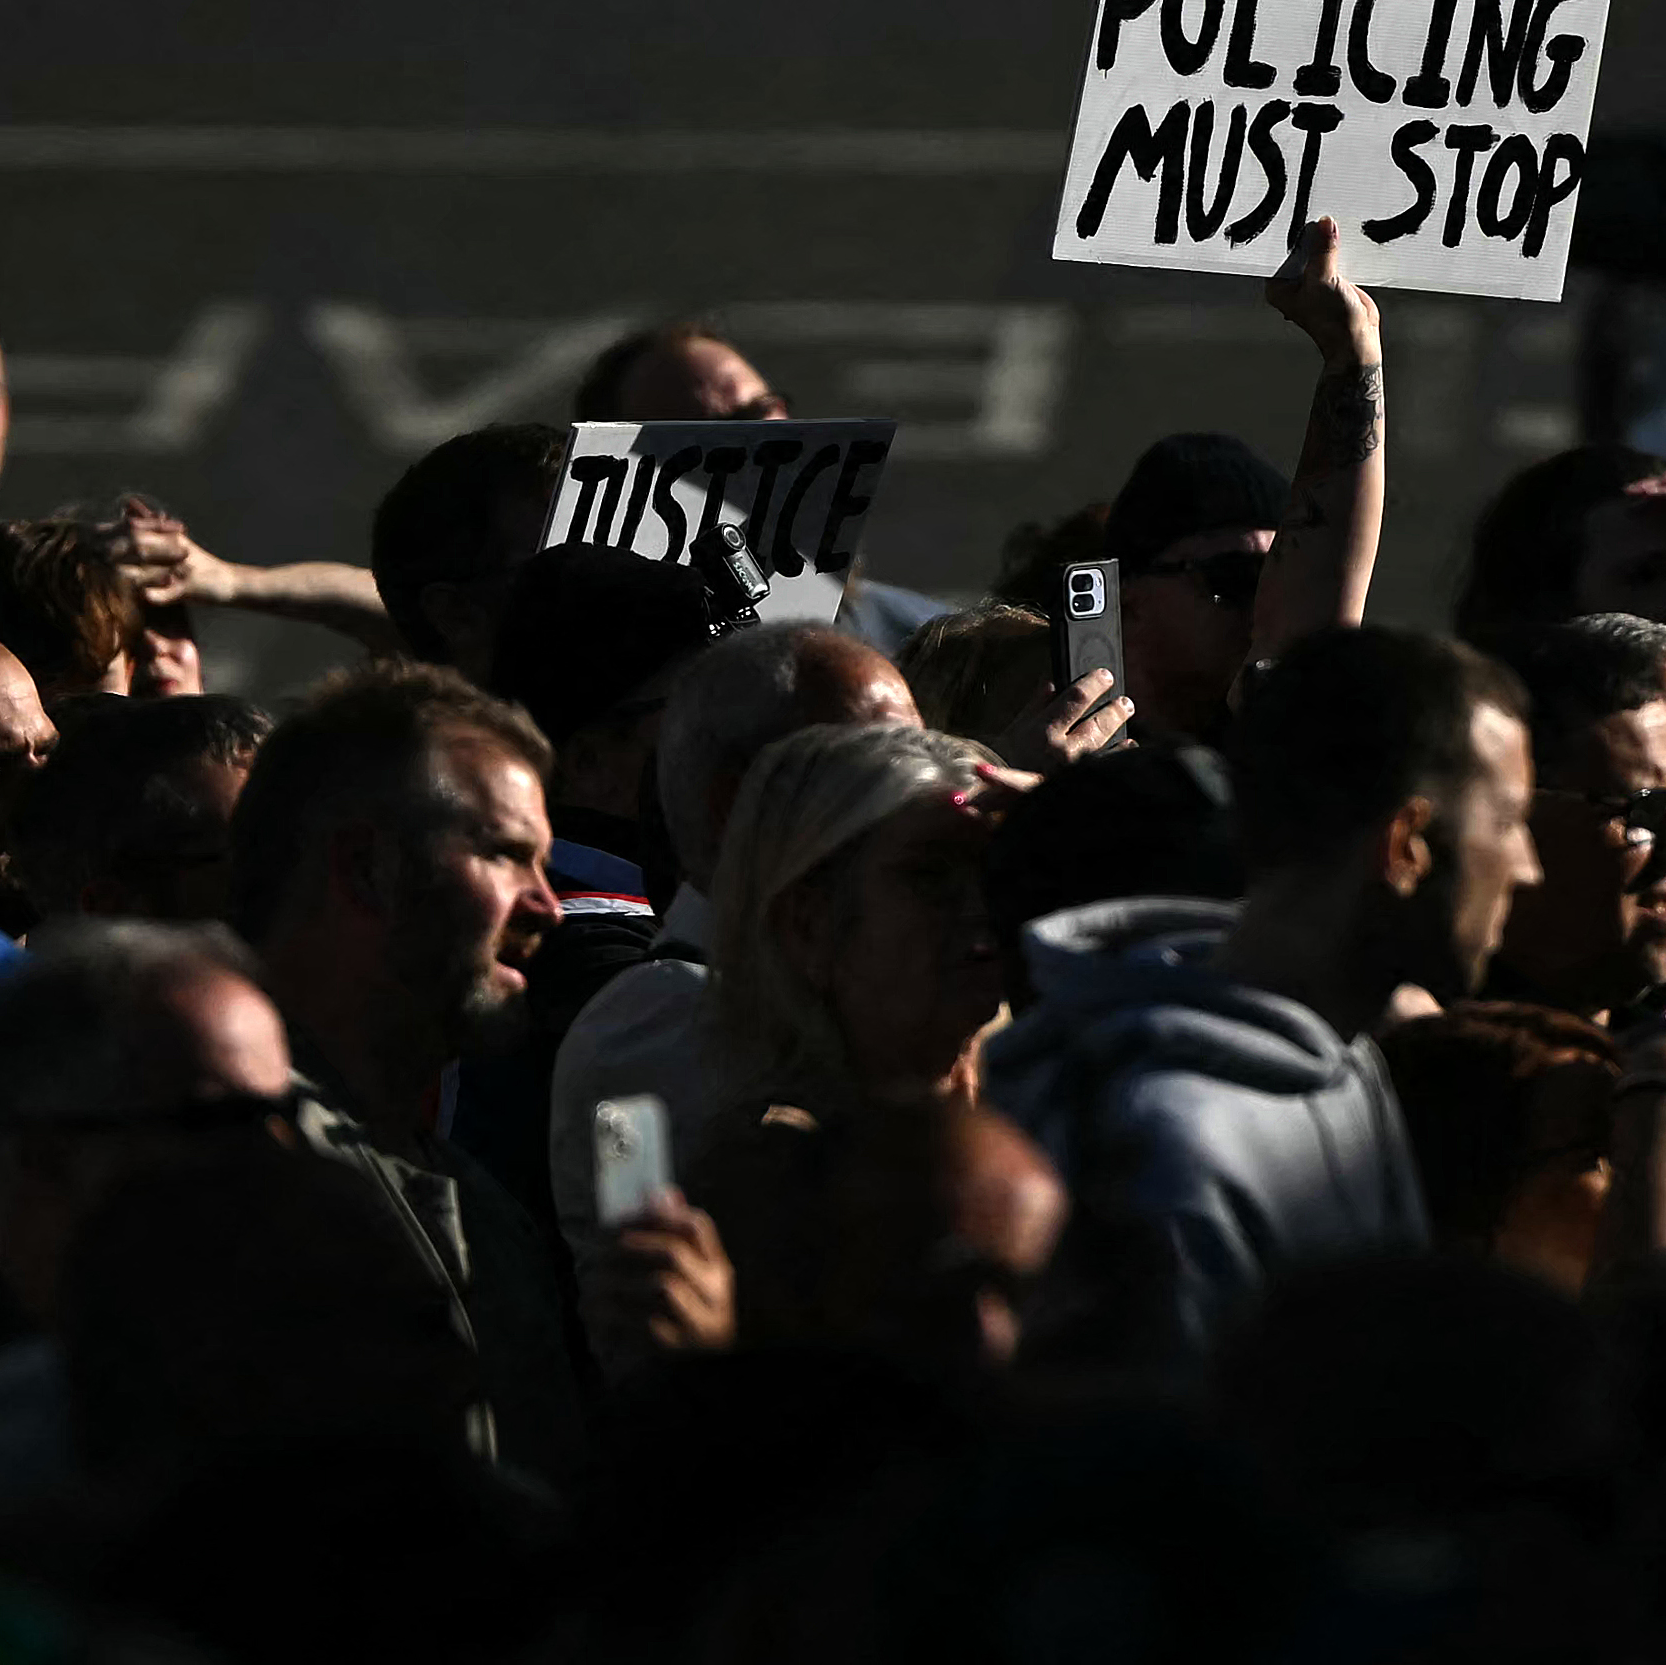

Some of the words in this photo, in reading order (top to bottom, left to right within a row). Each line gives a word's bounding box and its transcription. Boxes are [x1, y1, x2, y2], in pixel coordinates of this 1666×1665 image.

[1075, 96, 1345, 256] MUST
[1361, 118, 1587, 258] STOP
[565, 440, 889, 578] JUSTICE
